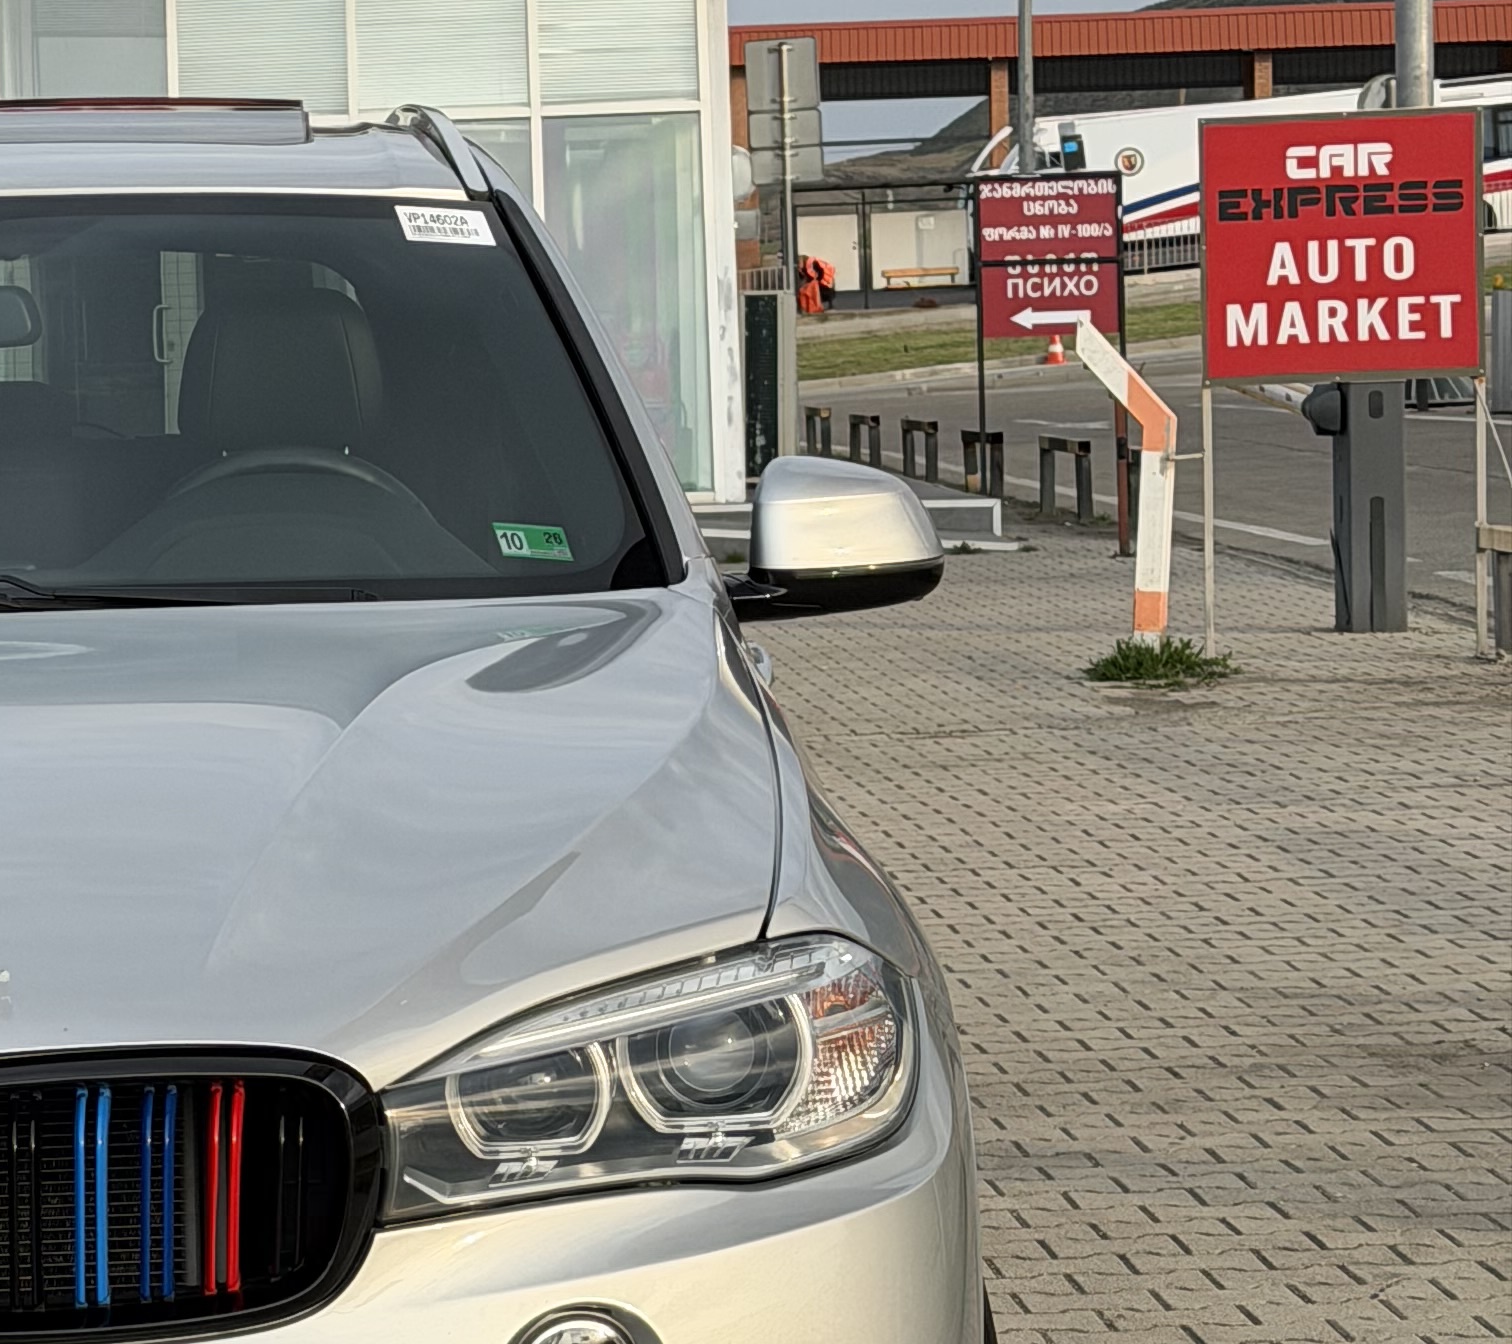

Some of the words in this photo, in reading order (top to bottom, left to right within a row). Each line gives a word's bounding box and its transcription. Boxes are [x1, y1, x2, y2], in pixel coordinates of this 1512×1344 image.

[1285, 142, 1393, 180] CAR
[979, 178, 1117, 199] ჯანმრთელობის
[1023, 199, 1078, 215] ცნობა
[1217, 179, 1465, 222] EXPRESS
[982, 226, 1036, 241] ფორმა
[1266, 236, 1415, 286] AUTO
[1006, 275, 1099, 298] ПСИХО
[1226, 294, 1462, 347] MARKET
[500, 532, 524, 551] 10
